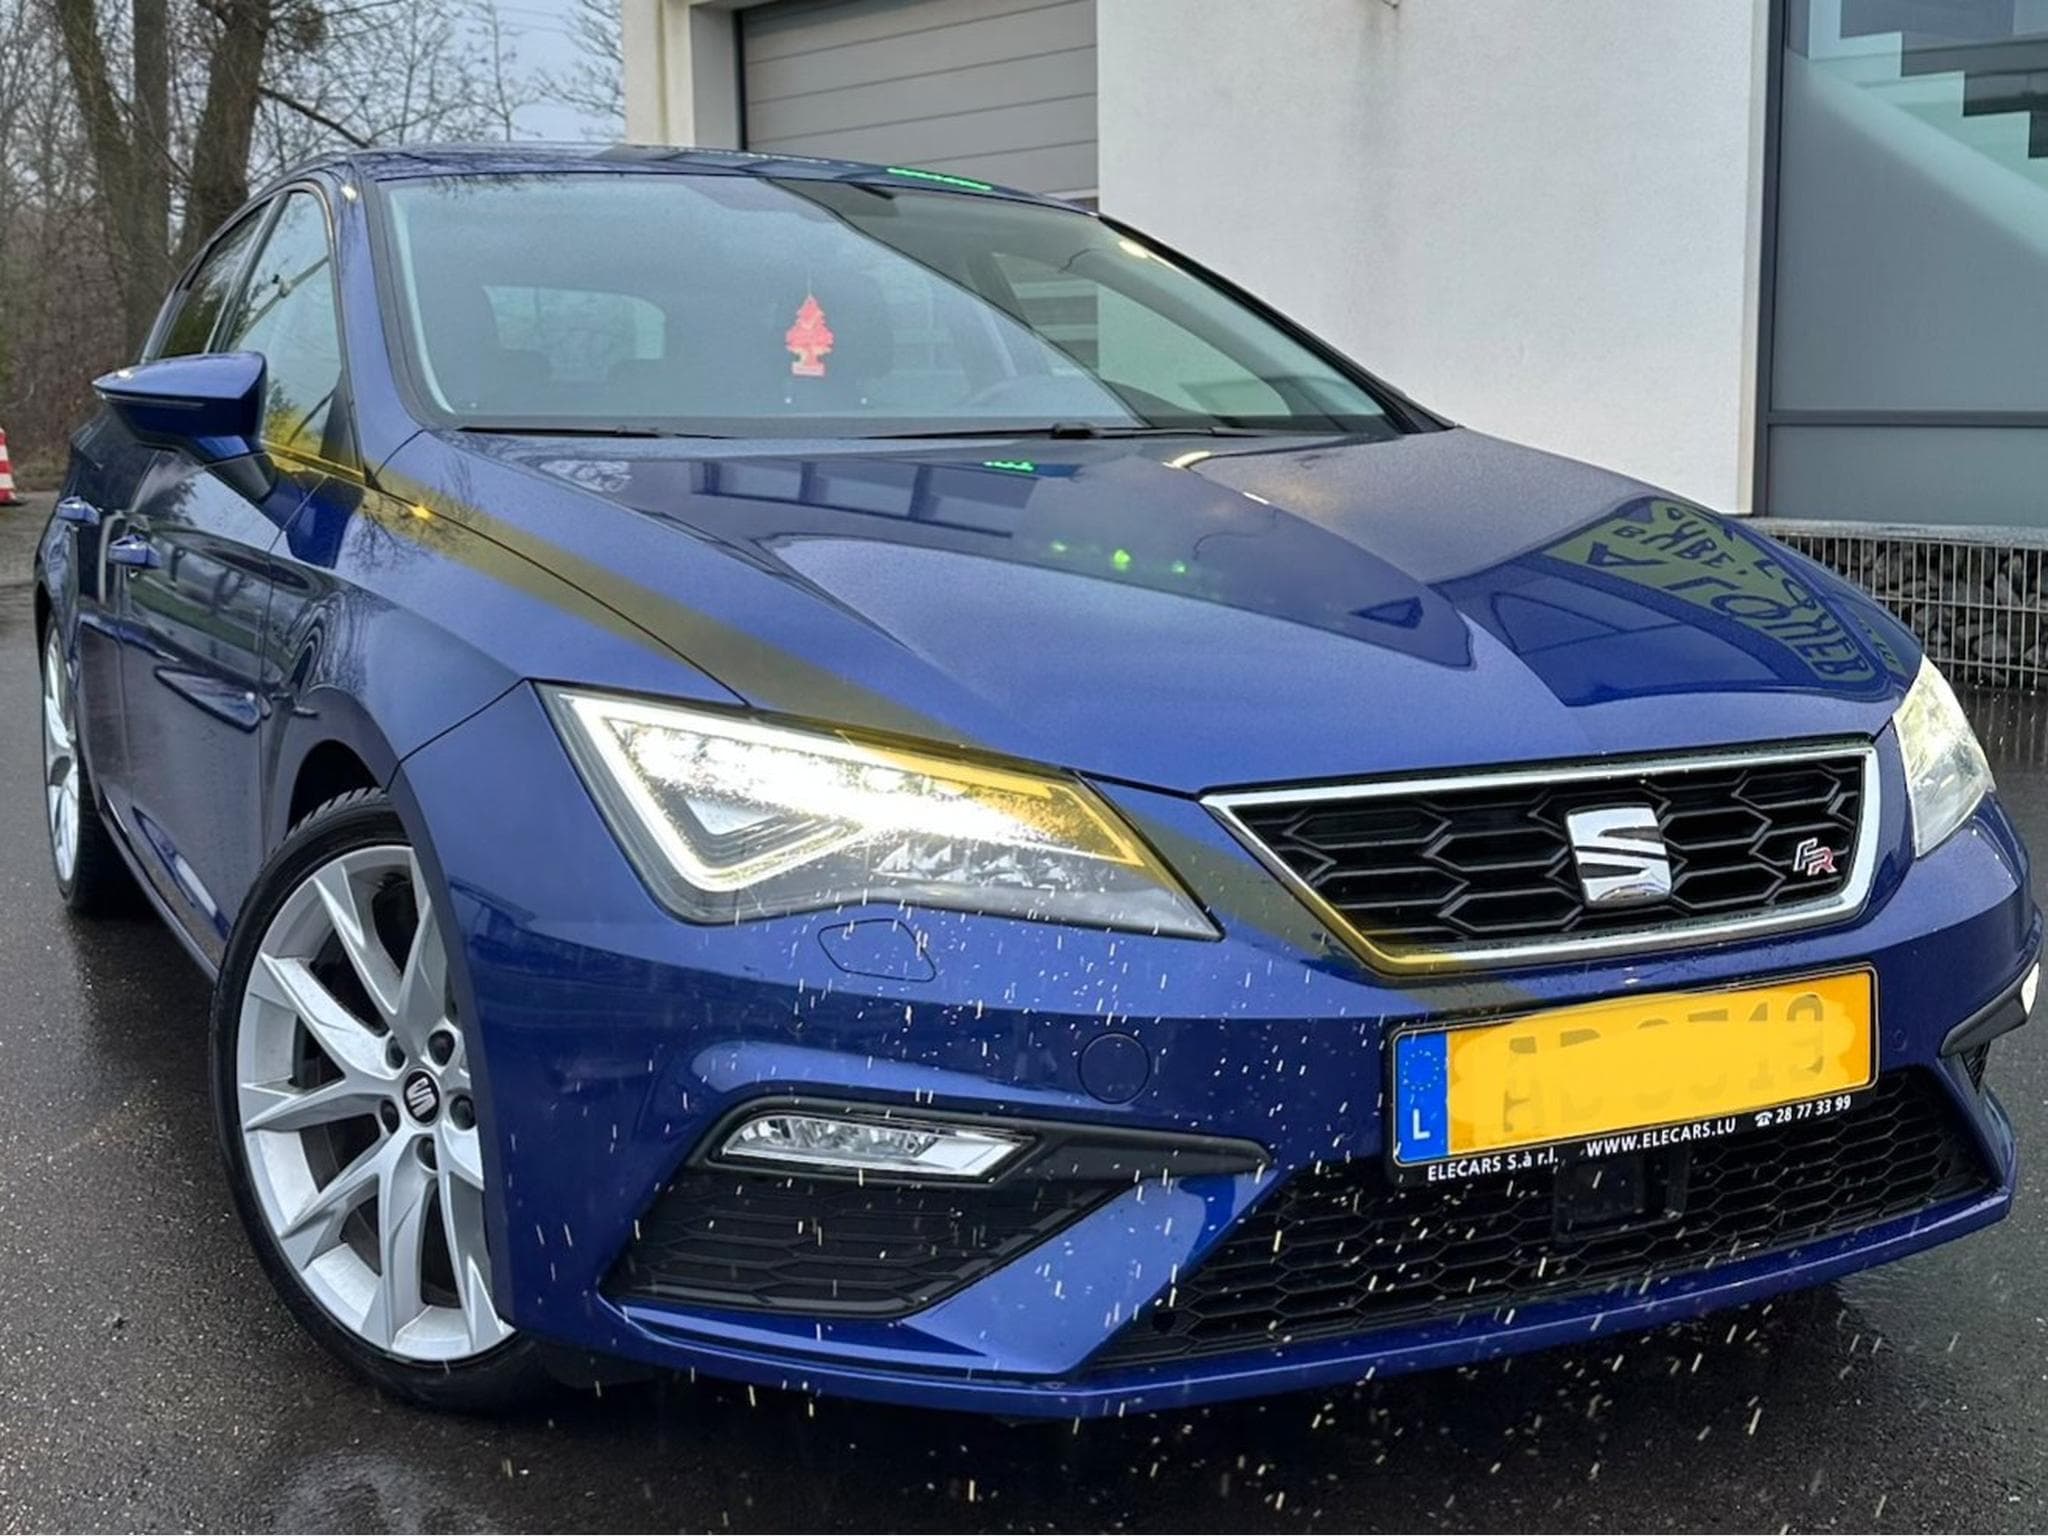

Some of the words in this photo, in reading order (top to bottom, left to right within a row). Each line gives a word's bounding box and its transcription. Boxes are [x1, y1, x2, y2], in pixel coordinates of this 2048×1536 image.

[1413, 1108, 1430, 1140] L
[1775, 1106, 1793, 1124] 28
[1796, 1102, 1813, 1119] 77
[1815, 1098, 1832, 1116] 33
[1835, 1094, 1852, 1111] 99
[1586, 1117, 1737, 1157] WWW.ELECARS.LU
[1427, 1156, 1502, 1181] ELECARS
